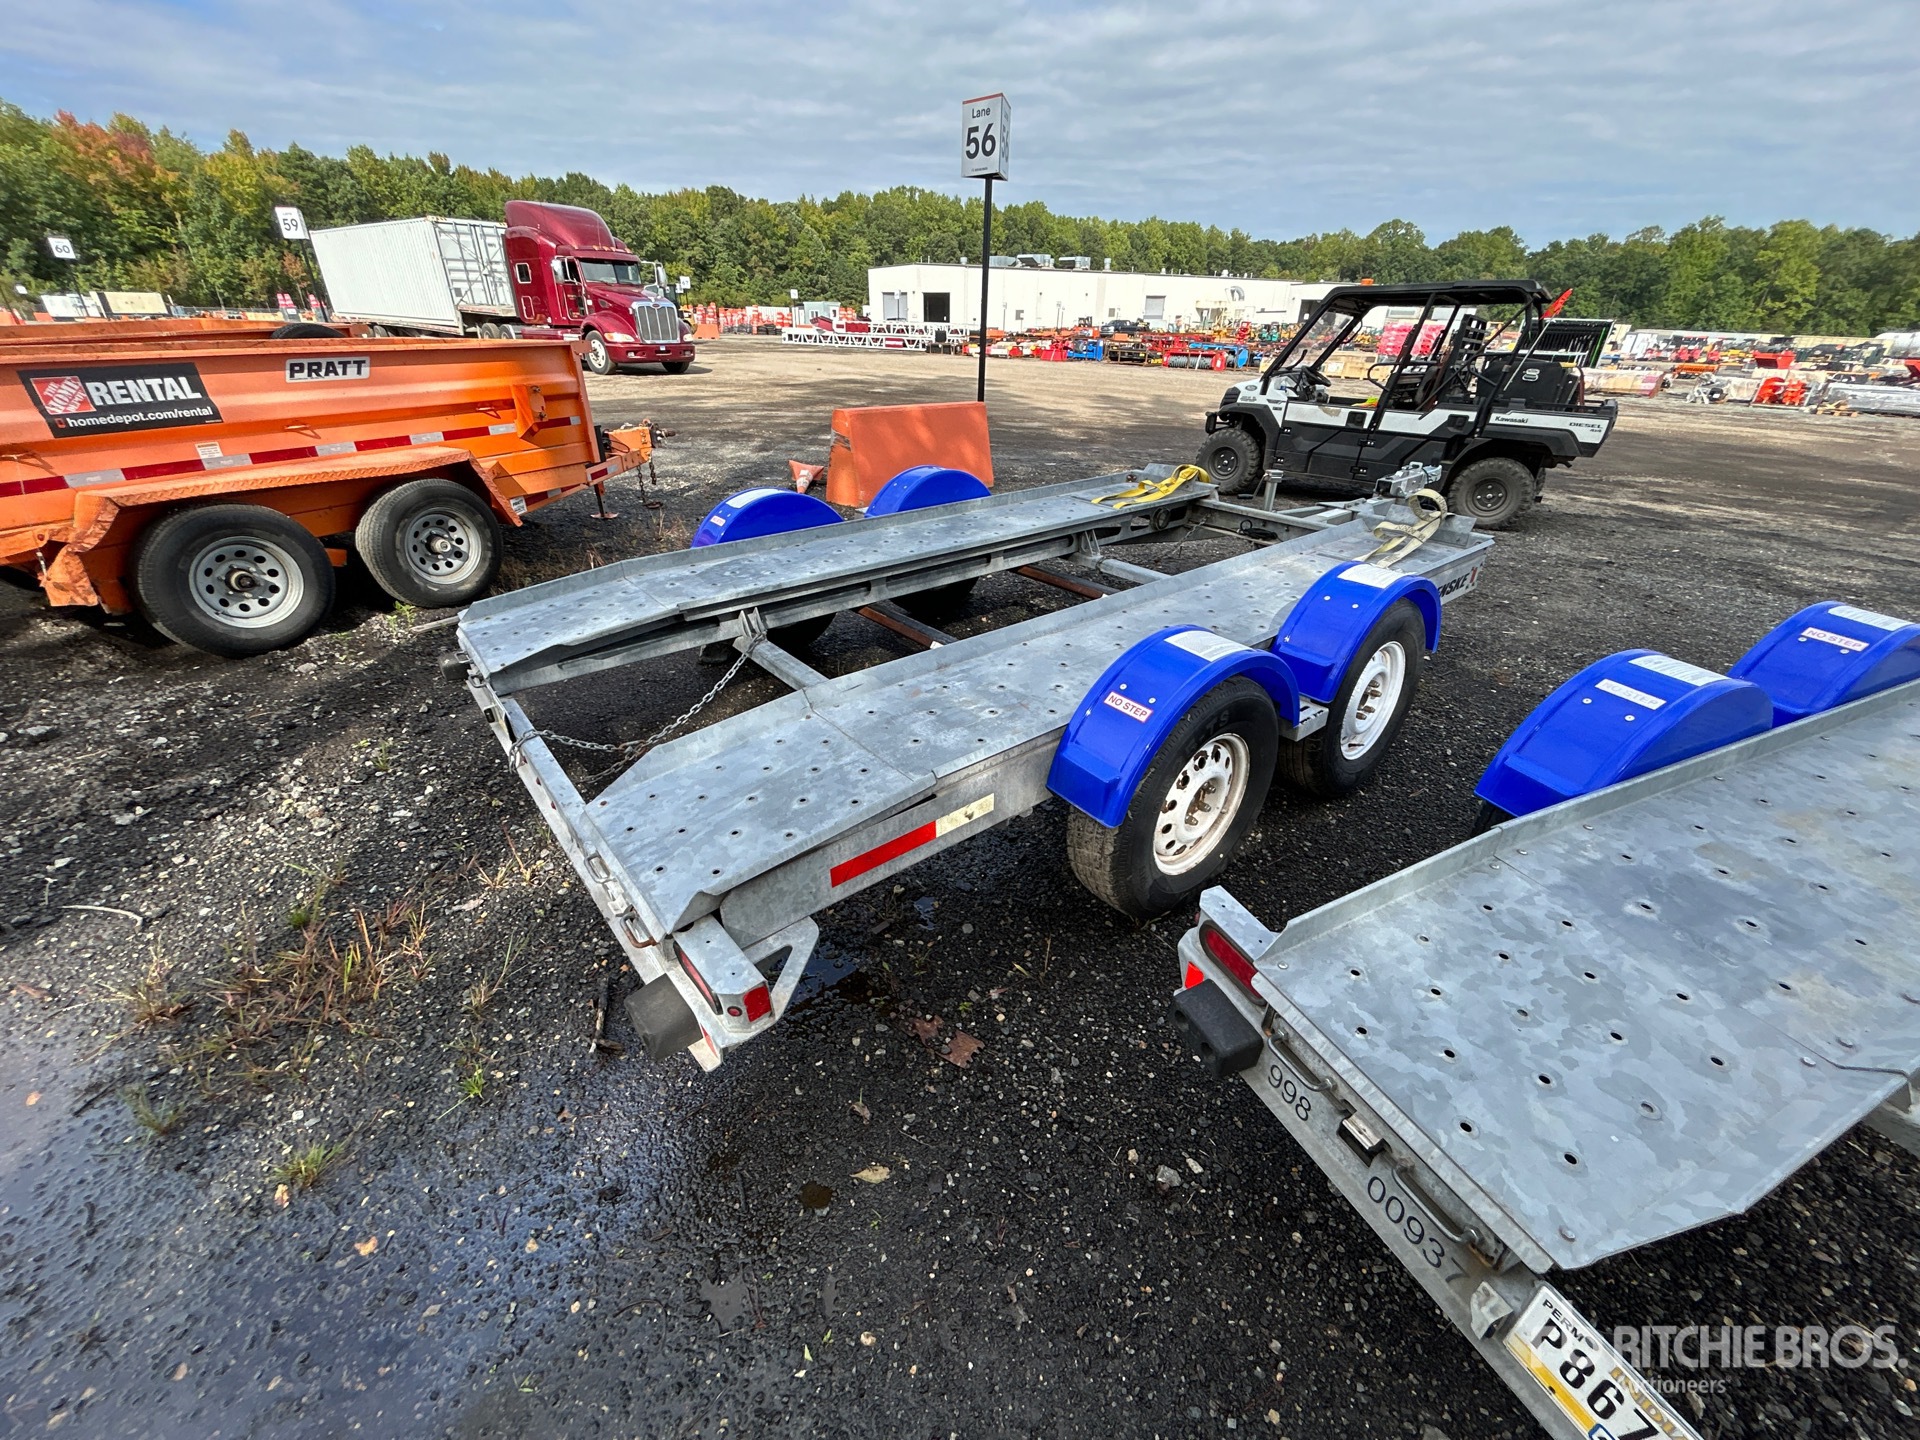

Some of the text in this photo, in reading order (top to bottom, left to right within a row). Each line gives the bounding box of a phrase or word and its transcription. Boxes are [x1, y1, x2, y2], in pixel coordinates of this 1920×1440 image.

[971, 107, 991, 119] Lane
[965, 122, 997, 160] 56
[282, 218, 299, 232] 59
[54, 244, 71, 254] 60
[289, 359, 367, 379] PRATT
[43, 381, 61, 397] THE
[45, 376, 81, 414] HOME
[85, 376, 202, 407] RENTAL
[65, 389, 88, 412] DEPOT
[66, 406, 213, 428] homedepot.com/rental
[1494, 415, 1528, 424] Kawasaki
[1806, 630, 1862, 648] NO STEP
[1602, 682, 1659, 705] NO STEP
[1108, 695, 1148, 717] NO STEP
[1267, 1064, 1471, 1284] 998 00937
[1542, 1299, 1585, 1343] PERM
